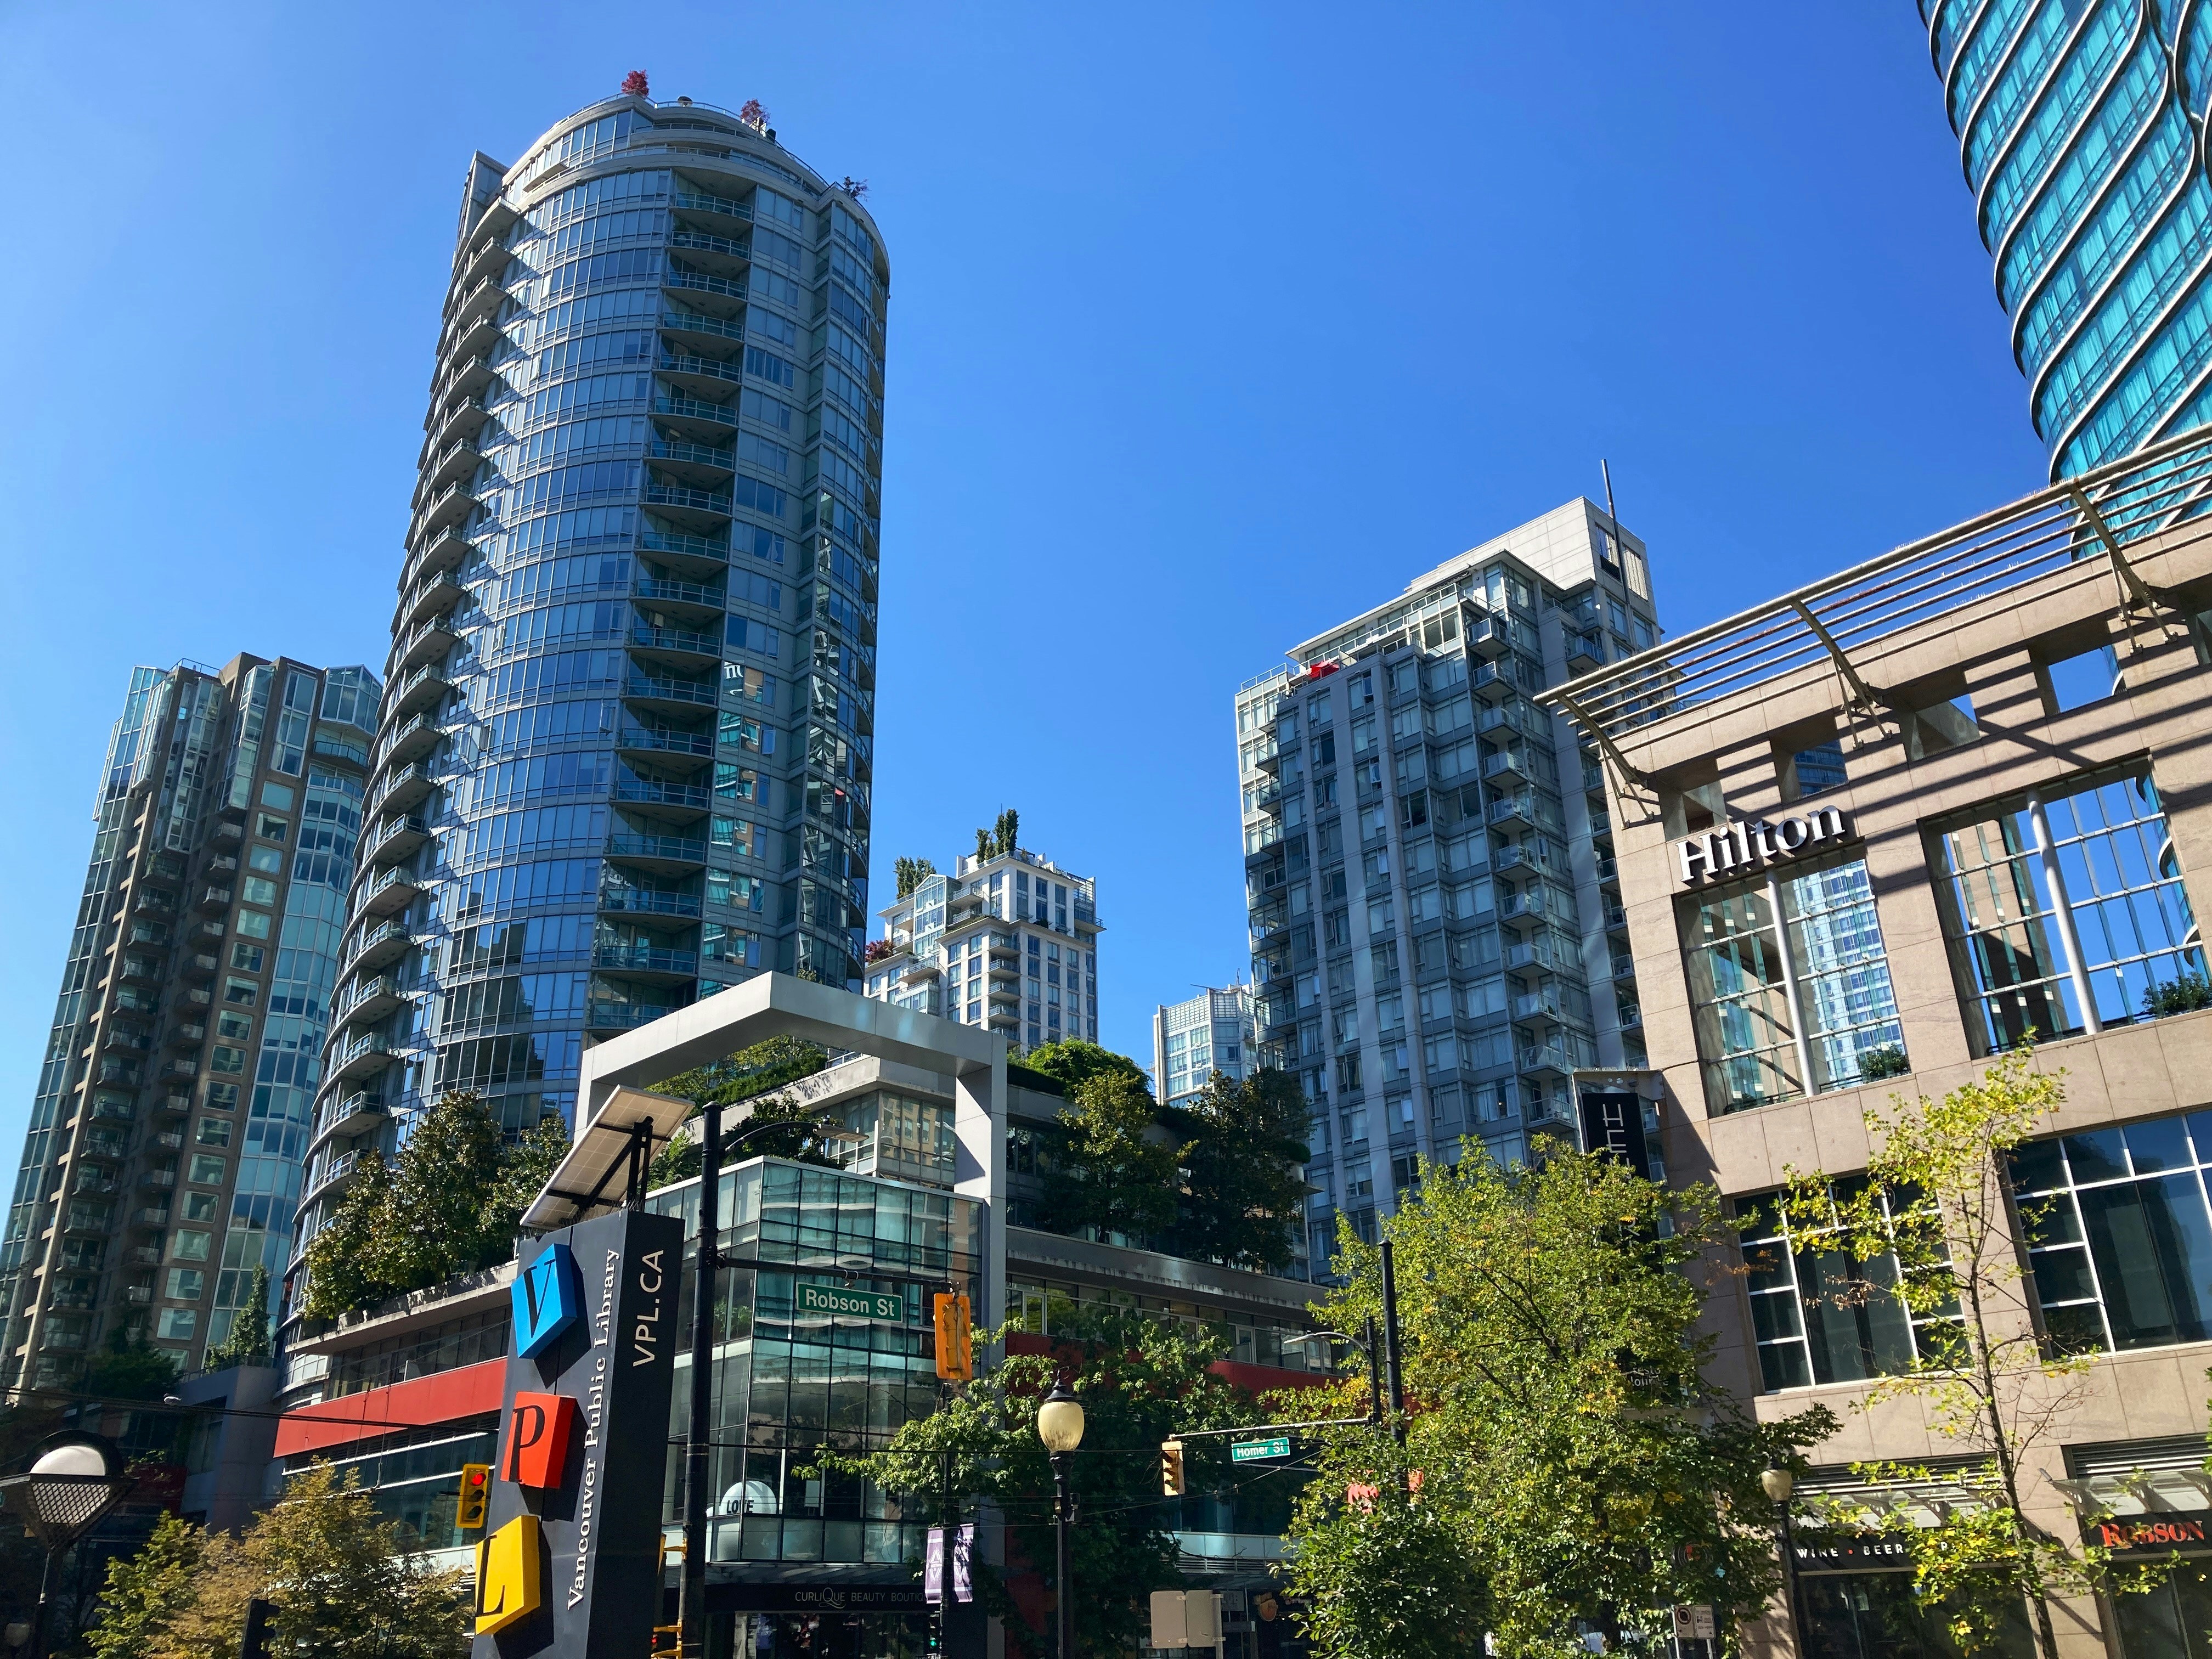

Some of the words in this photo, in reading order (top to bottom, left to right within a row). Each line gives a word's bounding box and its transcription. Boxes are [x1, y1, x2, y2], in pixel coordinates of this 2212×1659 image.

[1675, 805, 1845, 882] Hilton
[594, 1249, 620, 1348] Library
[633, 1250, 664, 1367] VPL.CA
[806, 1289, 869, 1313] Robson
[877, 1299, 894, 1317] St
[584, 1357, 606, 1449] Public
[1237, 1446, 1269, 1457] Homer
[1273, 1441, 1284, 1453] St
[567, 1458, 596, 1610] Vancouver
[1797, 1548, 1838, 1559] WINE
[1864, 1543, 1904, 1555] BEER
[2100, 1520, 2205, 1549] ROBSON
[795, 1587, 846, 1609] CURLIQUE
[851, 1593, 885, 1601] BEAUTY
[891, 1593, 924, 1602] BOUTIQ
